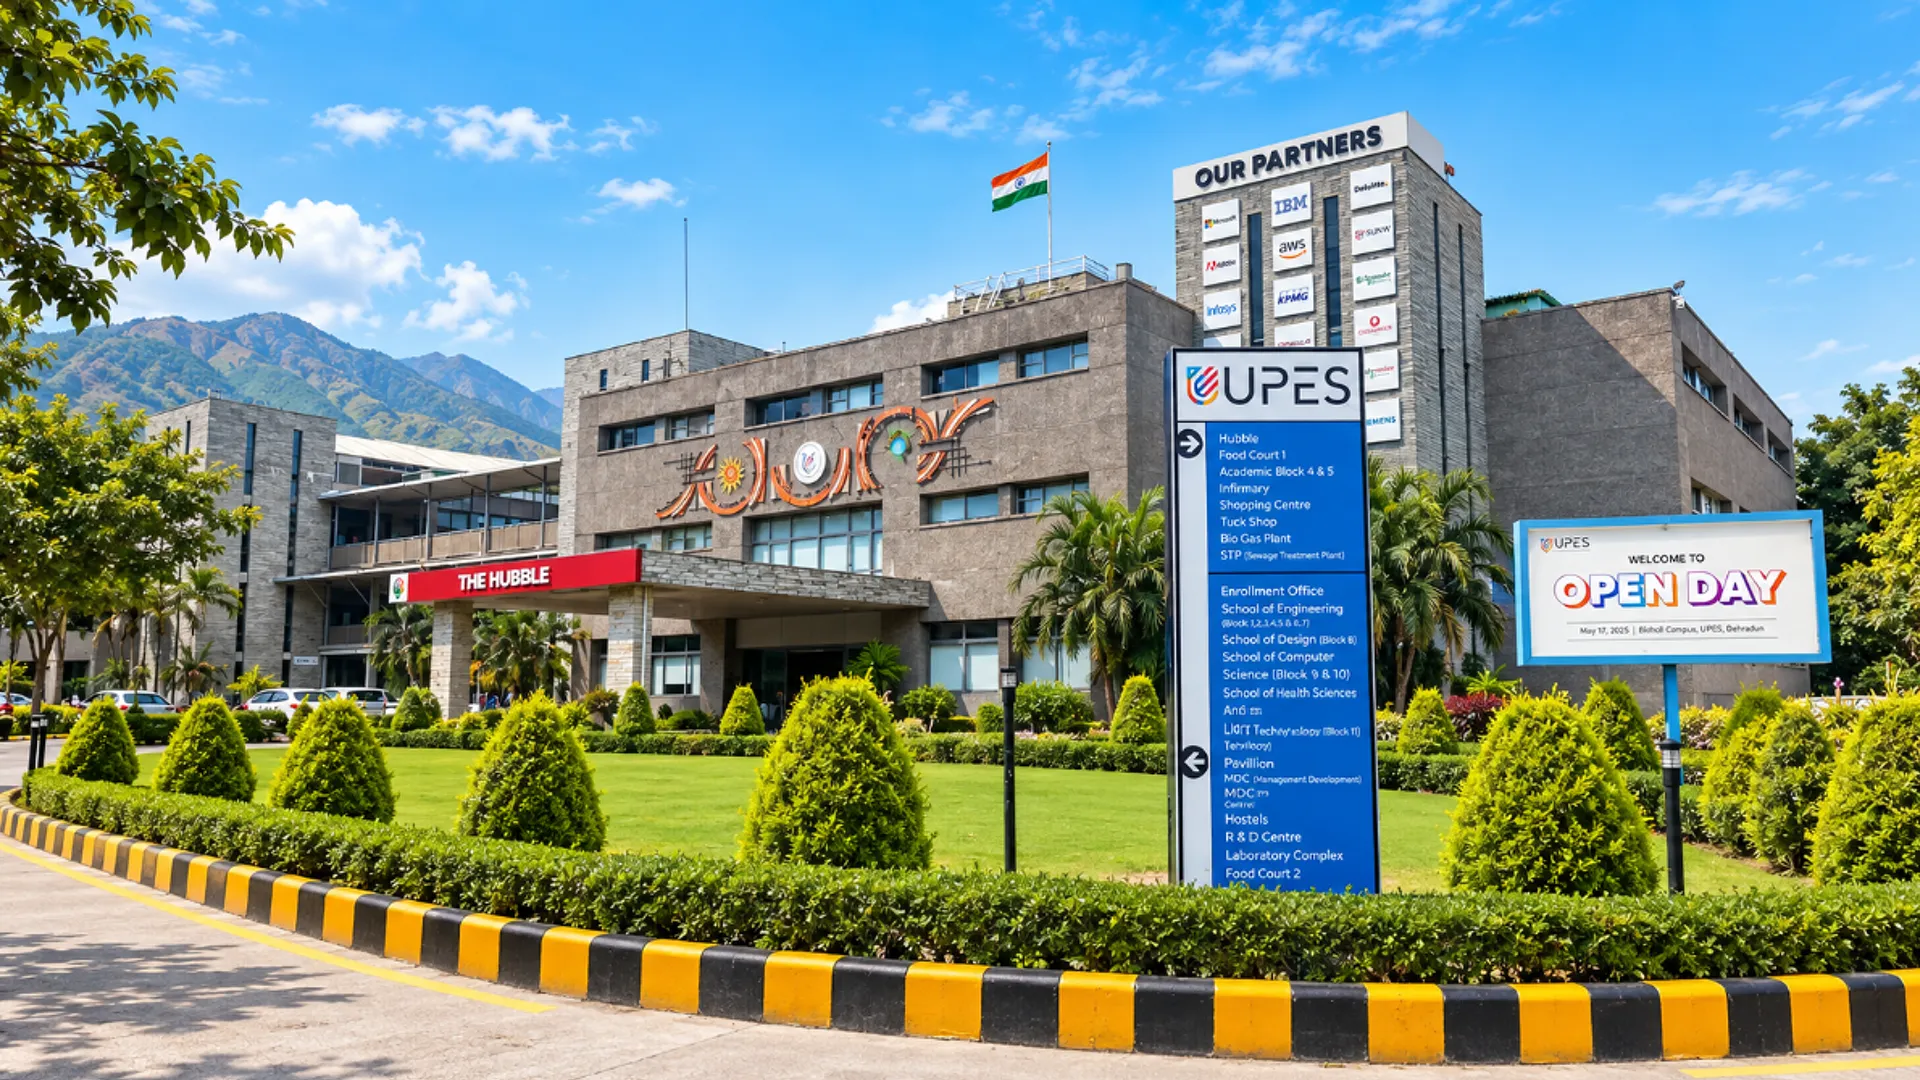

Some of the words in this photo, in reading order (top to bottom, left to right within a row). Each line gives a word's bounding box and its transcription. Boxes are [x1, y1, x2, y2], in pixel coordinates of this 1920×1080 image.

[1195, 160, 1245, 188] OUR
[1252, 125, 1382, 175] PARTNERS
[1274, 194, 1308, 215] IBM
[1279, 238, 1306, 253] aws
[1277, 291, 1309, 305] KPMG
[1207, 303, 1237, 316] Infosys
[1224, 366, 1350, 405] UPES
[1220, 434, 1258, 443] Hubble
[1220, 450, 1246, 460] Food
[1249, 450, 1278, 460] Court
[1281, 449, 1286, 459] 1
[1220, 467, 1271, 476] Academic
[1276, 467, 1303, 476] Block
[1307, 467, 1315, 475] 4
[1316, 466, 1325, 477] &
[1327, 465, 1335, 477] 5
[1220, 483, 1269, 495] Infirmary
[1220, 500, 1271, 511] Shopping
[1274, 500, 1310, 509] Centre
[1222, 517, 1246, 526] Tuck
[1249, 517, 1277, 527] Shop
[1221, 534, 1238, 543] Bio
[1241, 534, 1261, 543] Gas
[1265, 534, 1290, 542] Plant
[1554, 537, 1590, 549] UPES
[1221, 550, 1241, 560] STP
[1244, 551, 1278, 562] (Sewage
[1279, 551, 1320, 559] Treatment
[1321, 551, 1345, 559] Plant)
[1628, 554, 1686, 564] WELCOME
[1689, 553, 1705, 563] TO
[458, 572, 486, 591] THE
[489, 565, 550, 589] HUBBLE
[1221, 586, 1284, 596] Enrollment
[1288, 585, 1323, 596] Office
[1553, 571, 1678, 609] OPEN
[1687, 569, 1787, 606] DAY
[1222, 604, 1259, 613] School
[1262, 603, 1274, 613] of
[1278, 603, 1343, 616] Engineering
[1580, 627, 1596, 637] May
[1610, 626, 1630, 635] 2025
[1223, 634, 1260, 644] School
[1263, 634, 1274, 644] of
[1278, 634, 1316, 647] Design
[1319, 635, 1346, 645] (Block
[1223, 652, 1260, 662] School
[1264, 652, 1275, 661] of
[1278, 652, 1334, 663] Computer
[1223, 669, 1268, 679] Science
[1272, 669, 1307, 680] (Block
[1311, 669, 1319, 680] 9
[1321, 668, 1331, 680] &
[1333, 669, 1351, 680] 10)
[1224, 688, 1259, 698] School
[1263, 687, 1274, 697] of
[1277, 688, 1310, 697] Health
[1313, 687, 1356, 697] Sciences
[1225, 758, 1274, 768] Pavillion
[1225, 774, 1249, 783] MDC
[1225, 788, 1254, 798] MDC
[1226, 814, 1268, 824] Hostels
[1225, 831, 1234, 842] R
[1236, 831, 1246, 843] &
[1248, 831, 1259, 843] D
[1262, 832, 1301, 842] Centre
[1226, 850, 1290, 862] Laboratory
[1294, 850, 1343, 861] Complex
[1226, 868, 1255, 878] Food
[1258, 868, 1290, 878] Court
[1293, 867, 1301, 879] 2
